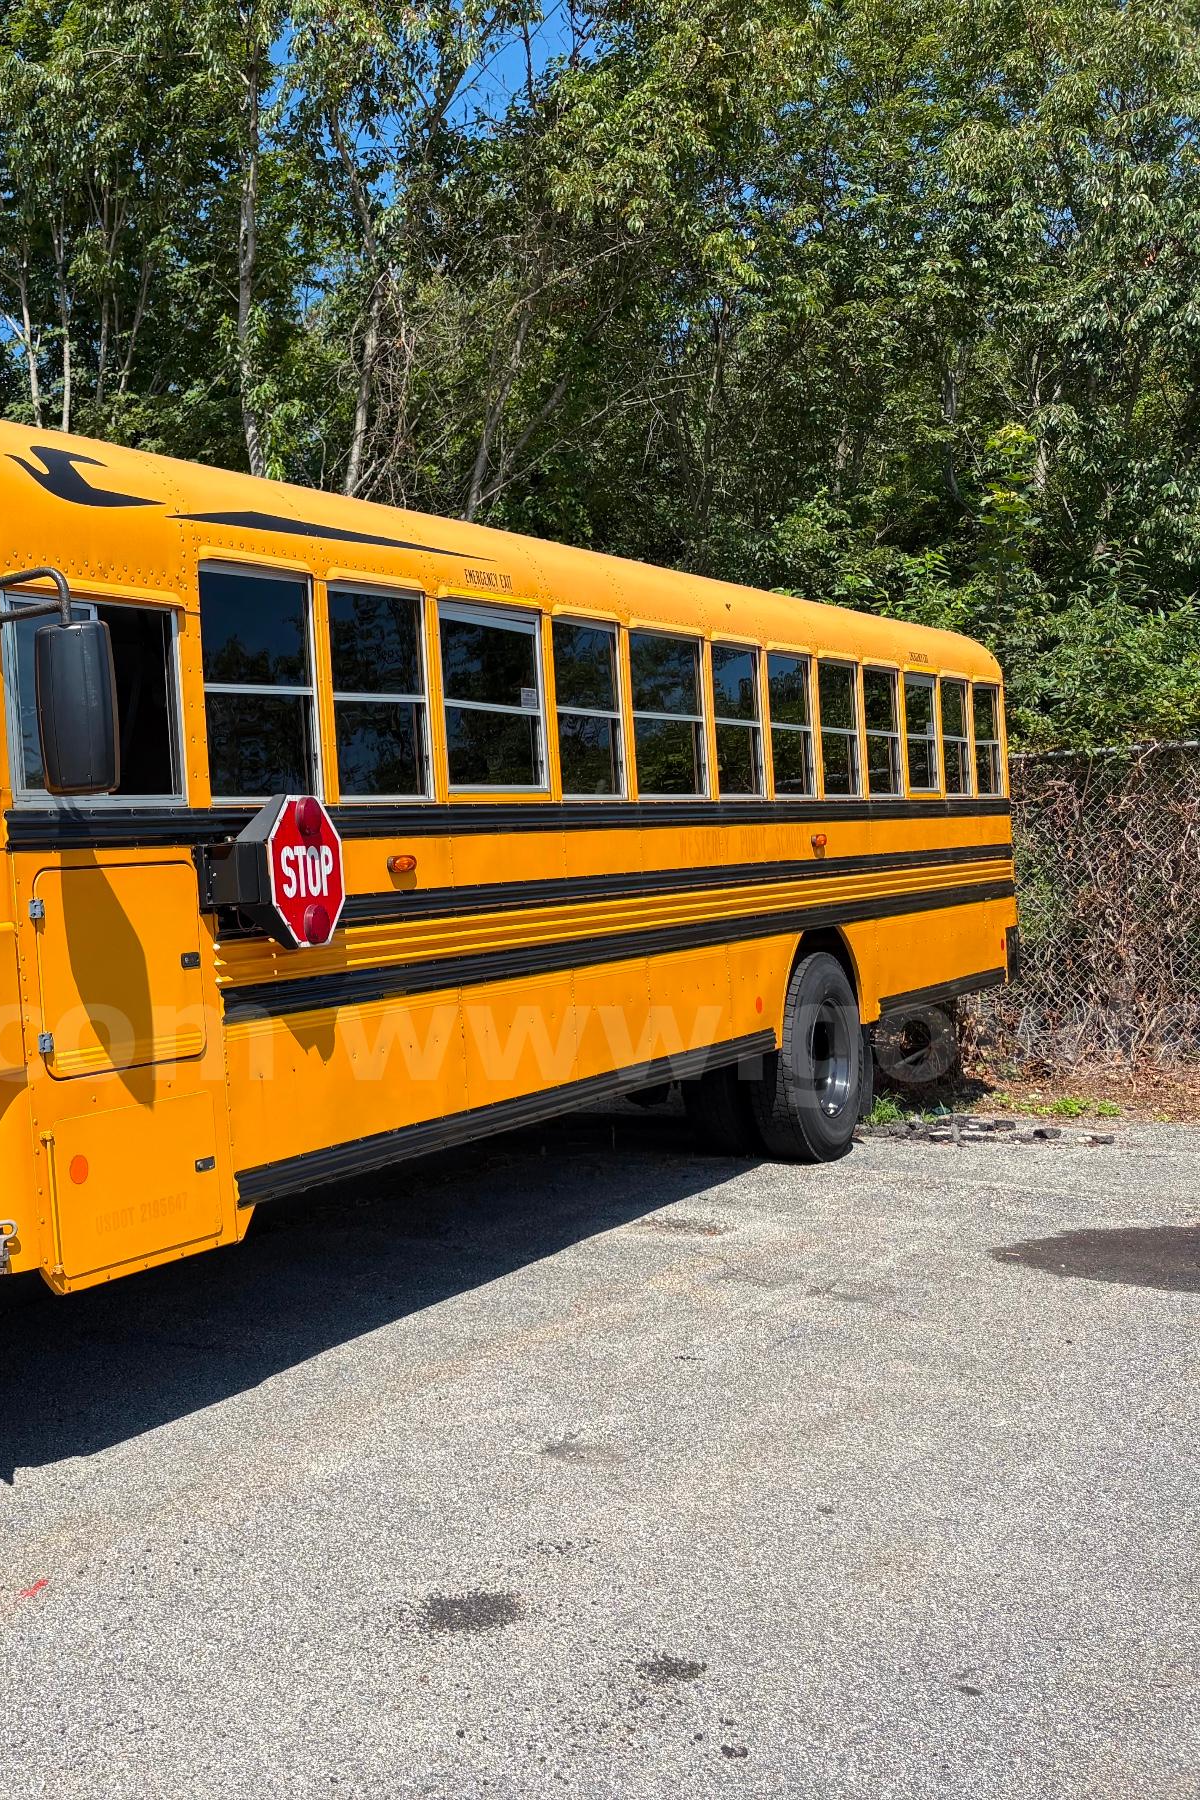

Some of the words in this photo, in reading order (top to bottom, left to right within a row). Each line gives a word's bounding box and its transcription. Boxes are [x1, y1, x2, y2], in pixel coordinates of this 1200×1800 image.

[463, 568, 498, 588] EMERGENCY
[498, 574, 513, 590] EXIT
[280, 845, 334, 899] STOP
[95, 1206, 135, 1237] USDOT
